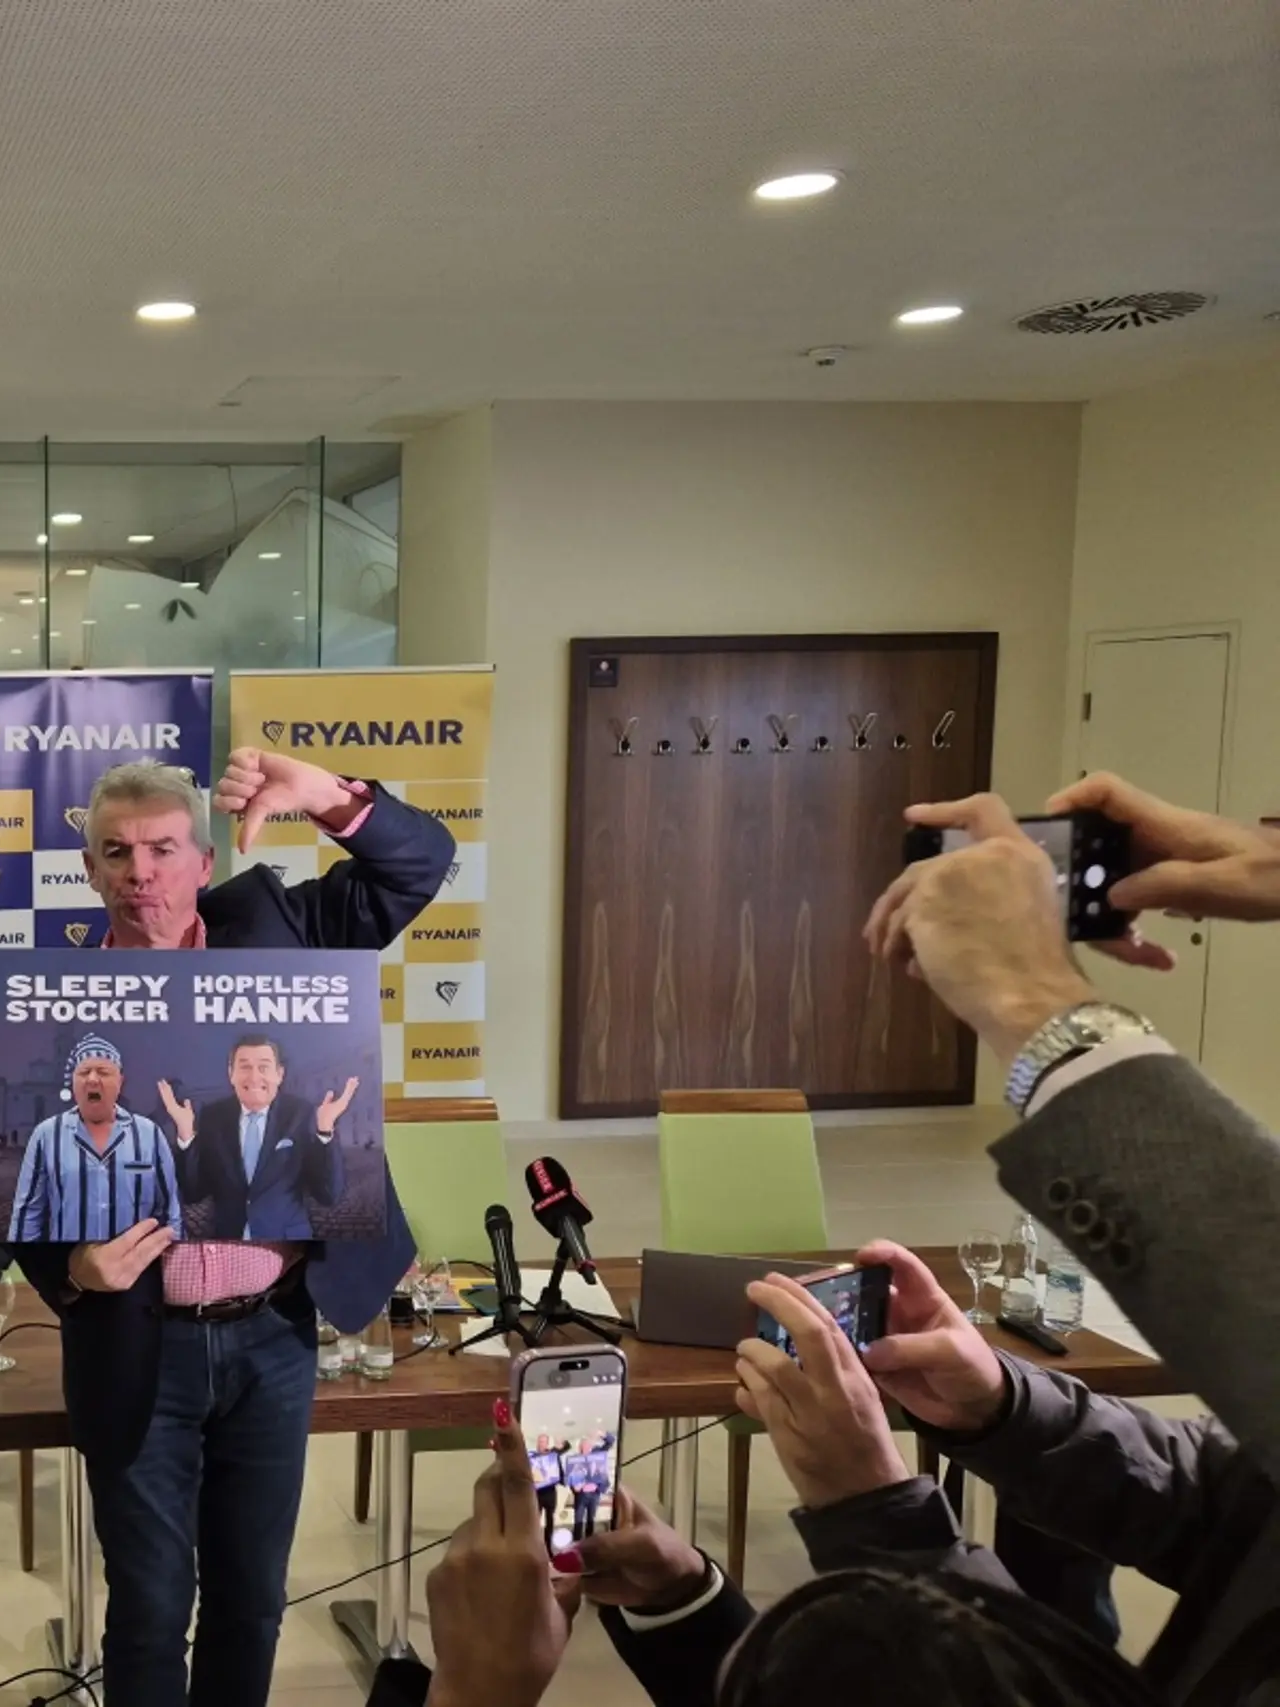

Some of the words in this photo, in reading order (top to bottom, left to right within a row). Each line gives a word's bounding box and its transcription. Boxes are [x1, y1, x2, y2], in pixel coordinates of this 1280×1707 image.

[4, 723, 180, 751] RYANAIR
[291, 720, 463, 747] RYANAIR
[41, 873, 91, 885] RYAN
[411, 928, 482, 941] RYANAIR
[6, 975, 169, 998] SLEEPY
[193, 975, 349, 993] HOPELESS
[6, 1001, 169, 1022] STOCKER
[193, 997, 350, 1023] HANKE
[411, 1046, 481, 1060] RYANAIR
